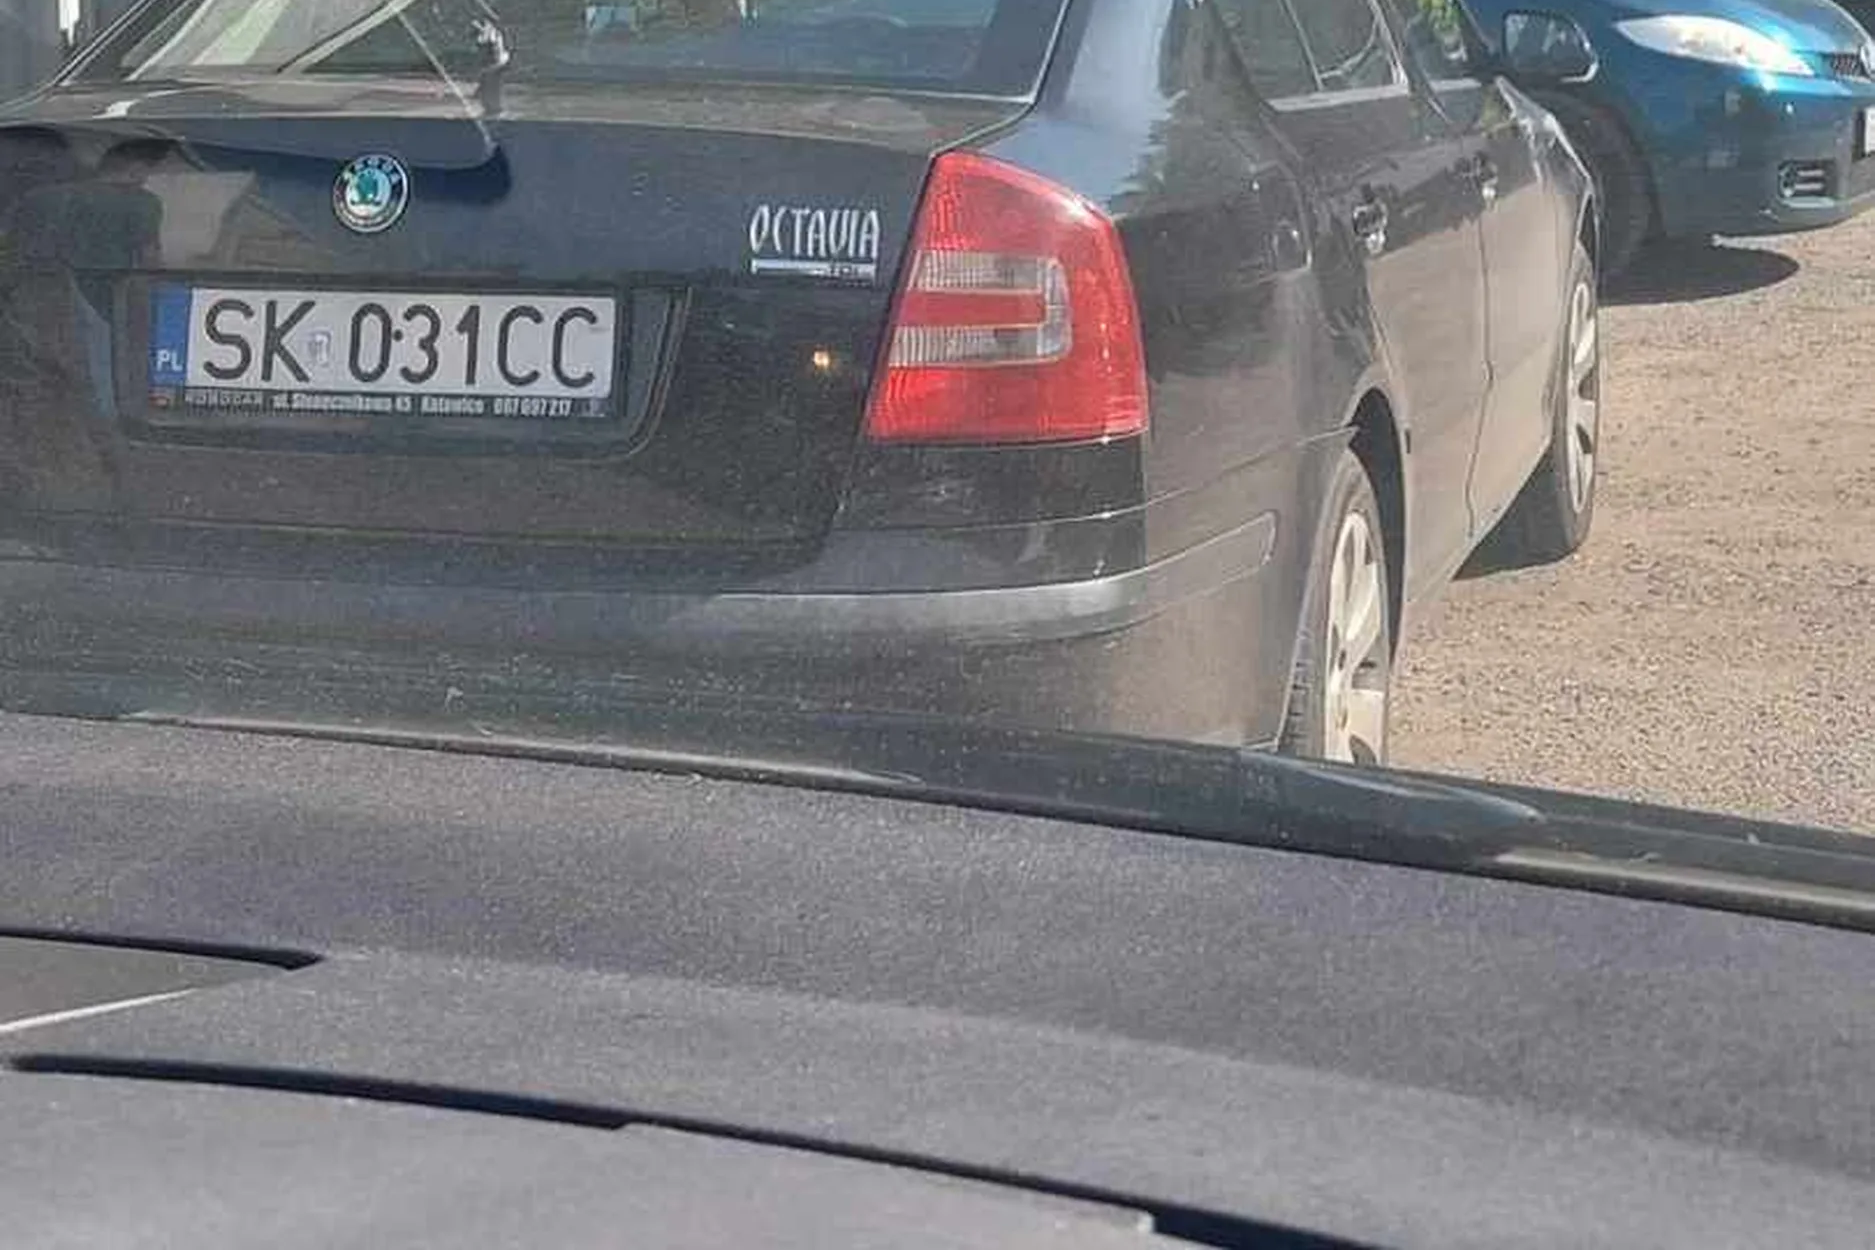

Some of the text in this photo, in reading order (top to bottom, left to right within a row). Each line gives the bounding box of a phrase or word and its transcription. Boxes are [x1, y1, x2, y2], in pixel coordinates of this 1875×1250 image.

[750, 203, 880, 259] OCTAVIA
[156, 350, 183, 373] PL
[203, 298, 598, 388] SK 031CC
